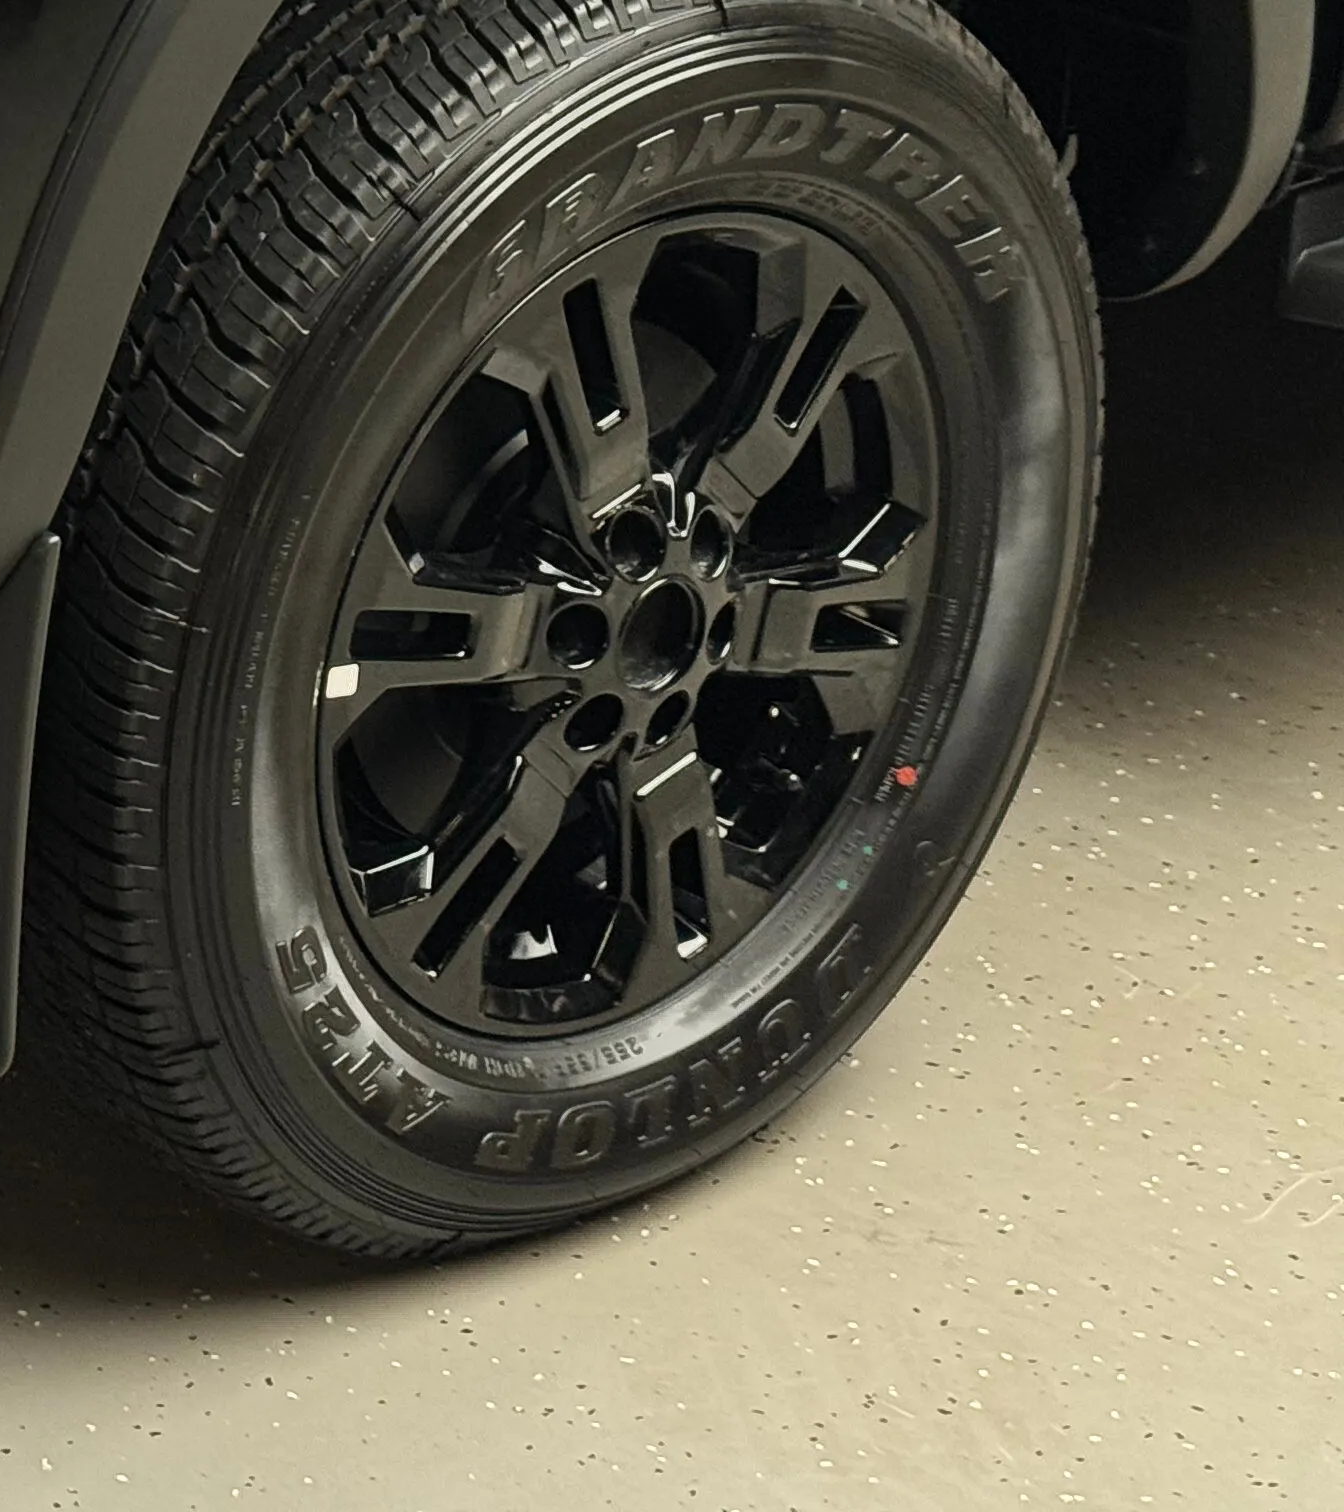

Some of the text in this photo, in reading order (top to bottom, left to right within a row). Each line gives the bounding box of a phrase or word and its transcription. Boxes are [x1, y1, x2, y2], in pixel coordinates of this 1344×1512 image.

[467, 101, 1026, 323] GRANDTREK
[275, 924, 452, 1137] AT25
[473, 921, 872, 1173] DUNLOP
